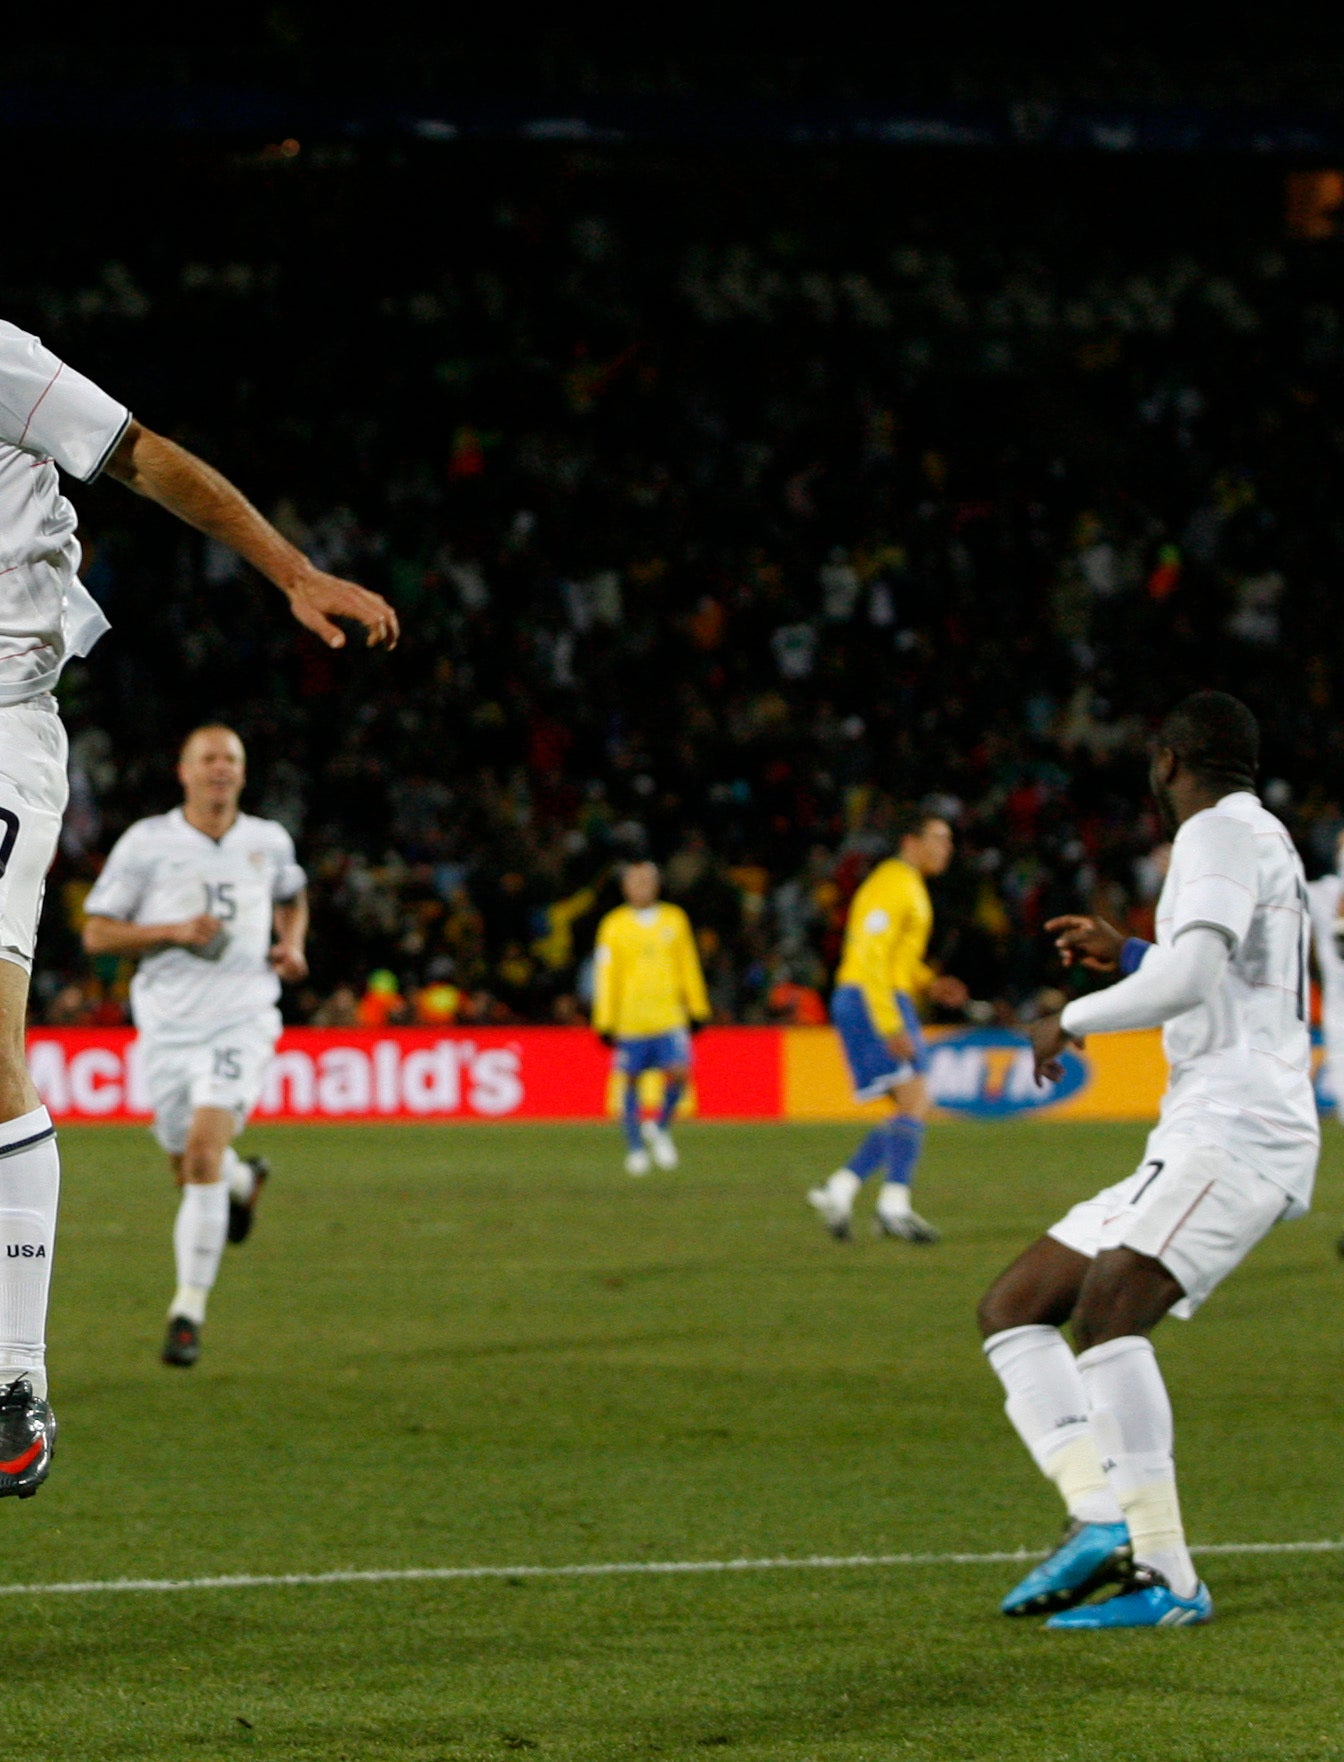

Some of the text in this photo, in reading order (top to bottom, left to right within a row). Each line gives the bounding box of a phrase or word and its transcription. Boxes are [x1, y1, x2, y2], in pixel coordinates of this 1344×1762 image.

[202, 882, 238, 920] 15
[24, 1039, 524, 1116] Mcnald's
[212, 1047, 242, 1080] 15
[6, 1244, 46, 1259] USA
